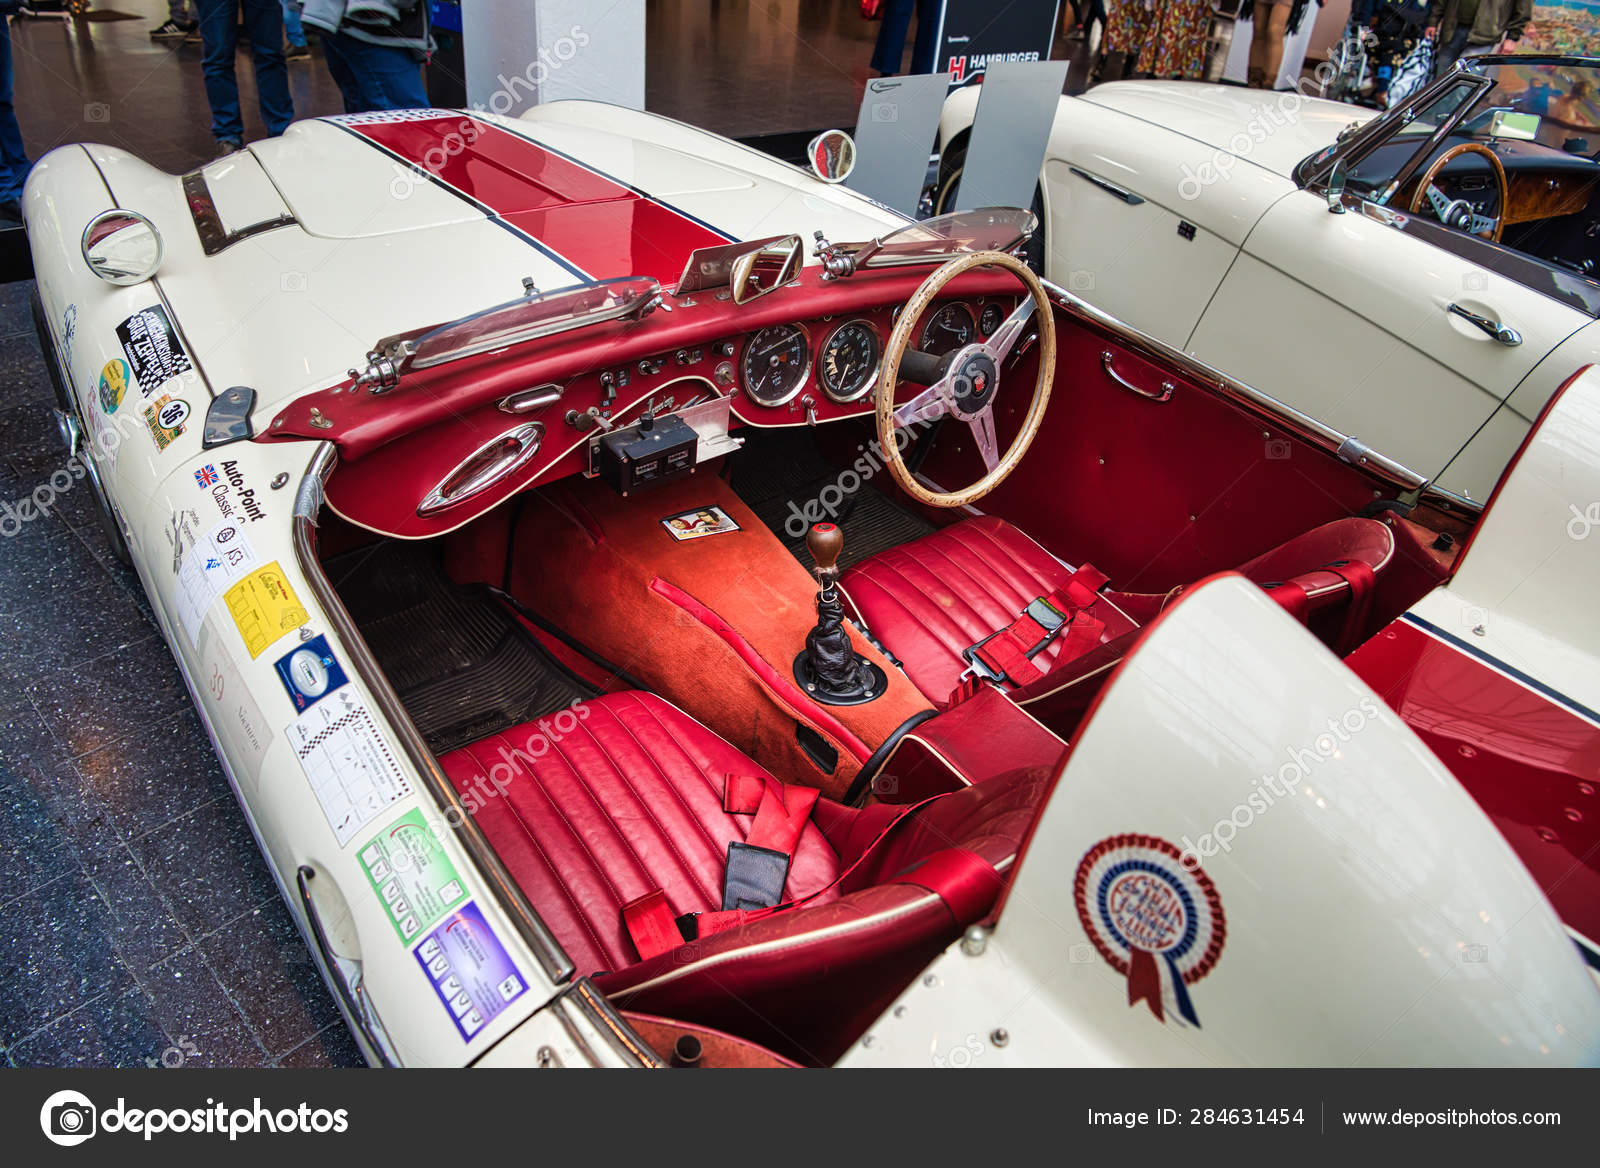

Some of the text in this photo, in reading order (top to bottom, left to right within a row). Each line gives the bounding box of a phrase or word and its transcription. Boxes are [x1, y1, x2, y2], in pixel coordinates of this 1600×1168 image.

[970, 52, 1039, 69] HAMBURGER
[126, 315, 168, 380] GRAF ZEPPELIN
[161, 403, 185, 426] 36
[211, 484, 234, 519] Classic
[220, 460, 267, 522] Auto-Point
